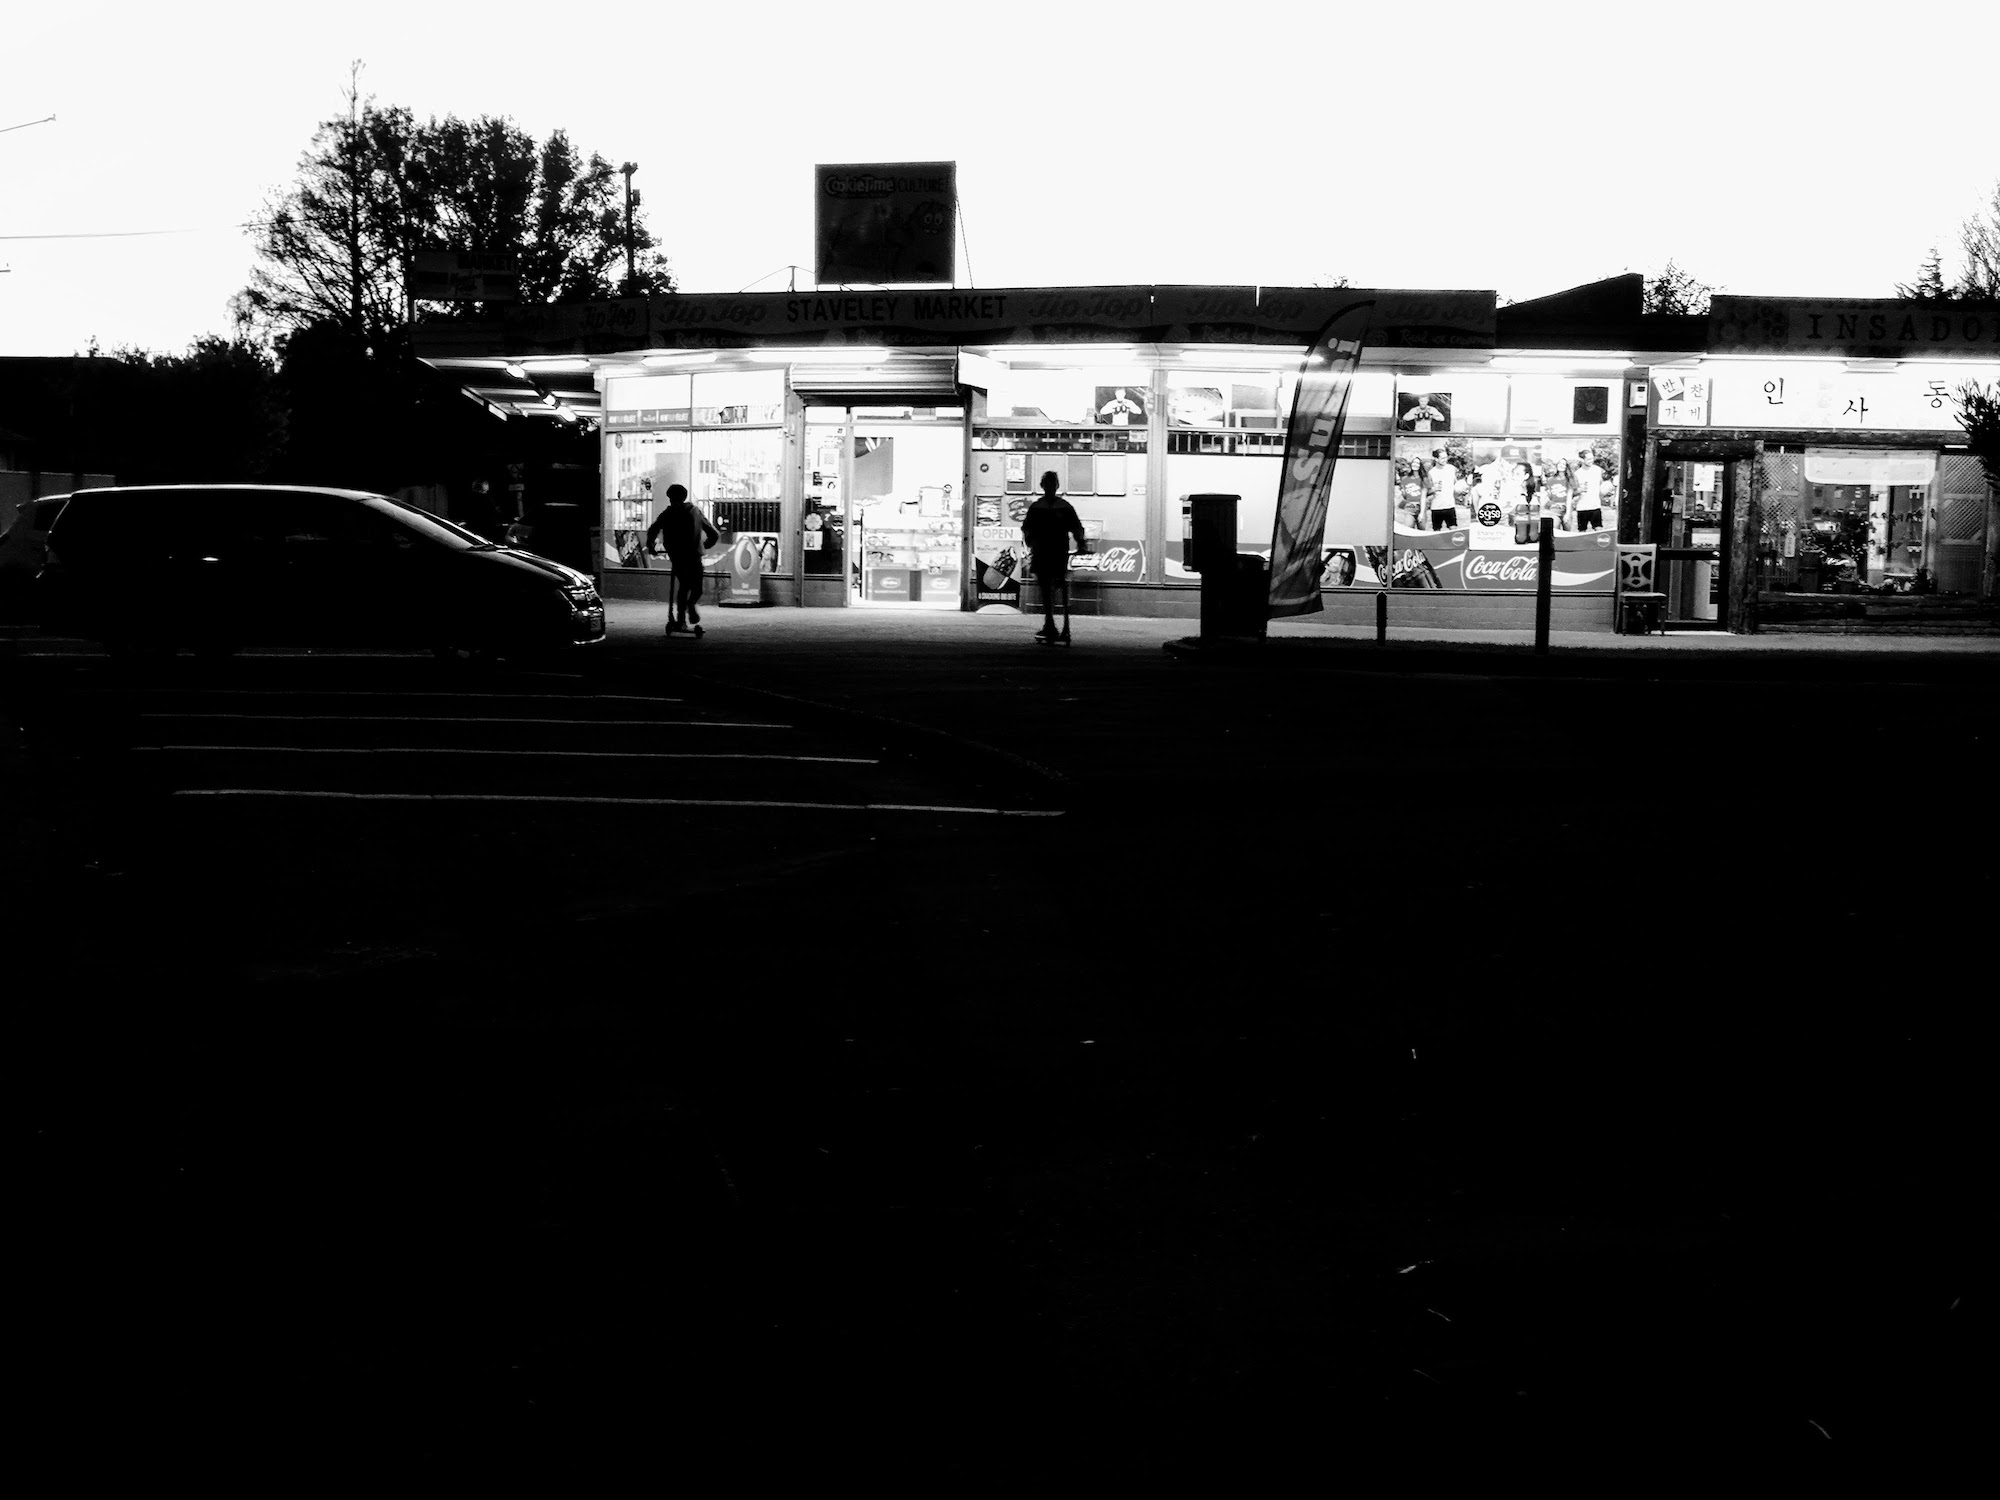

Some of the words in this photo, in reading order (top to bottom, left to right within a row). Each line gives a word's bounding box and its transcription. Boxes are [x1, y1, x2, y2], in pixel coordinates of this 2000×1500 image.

[659, 299, 705, 326] Tip
[711, 299, 767, 326] Top
[786, 297, 899, 322] STAVELEY
[914, 296, 1007, 320] MARKET
[1807, 312, 2000, 343] INSADO
[1763, 377, 1950, 424] 인사동
[982, 528, 1014, 539] OPEN
[1465, 554, 1538, 582] Coca-Cola
